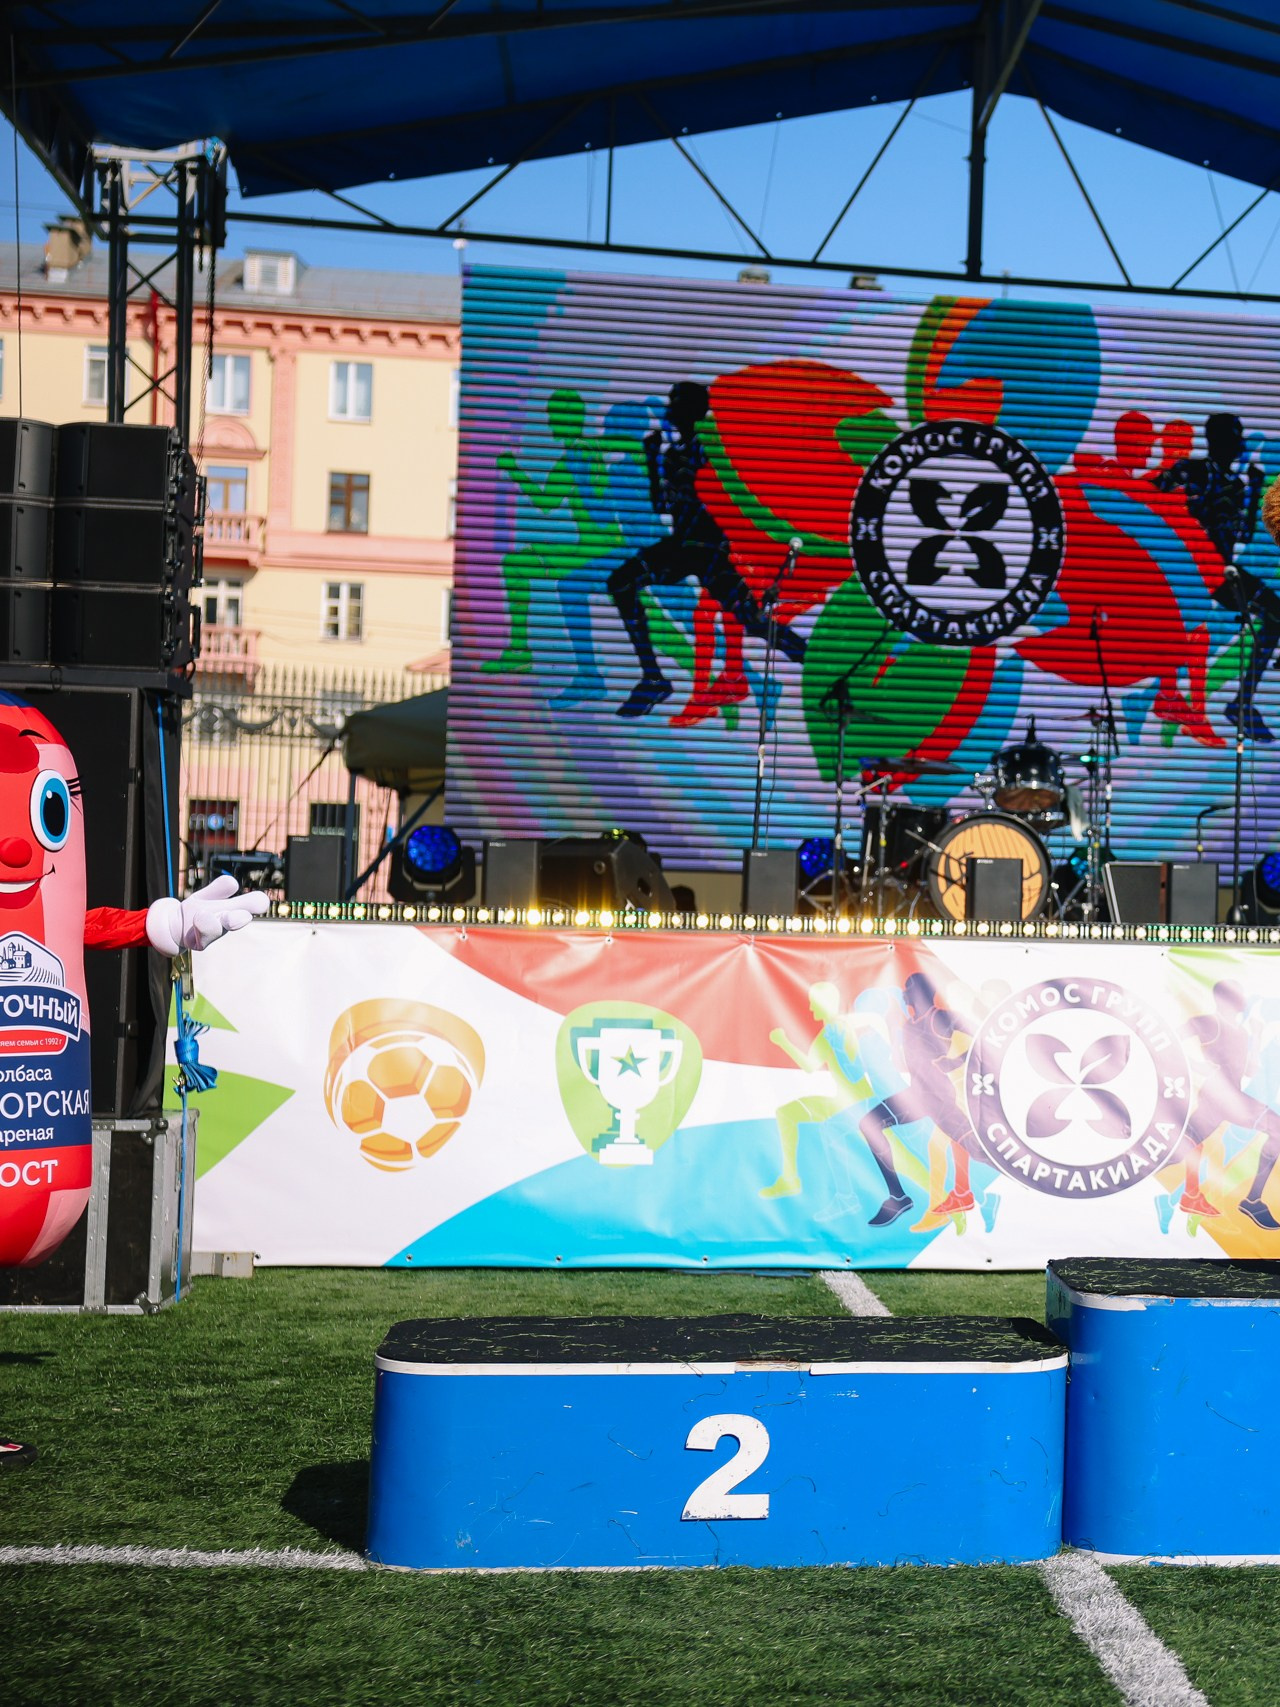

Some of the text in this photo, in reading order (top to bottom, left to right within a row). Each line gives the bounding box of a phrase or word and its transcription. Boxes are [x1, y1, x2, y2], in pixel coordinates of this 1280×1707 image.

[869, 427, 963, 494] КОМОС
[869, 570, 1050, 641] СПАРТАКИАДА
[17, 1039, 39, 1047] семьи
[45, 1037, 59, 1046] 1992
[984, 983, 1173, 1053] КОМОС ГРУПП
[986, 1121, 1177, 1193] СПАРТАКИАДА
[682, 1414, 769, 1519] 2
